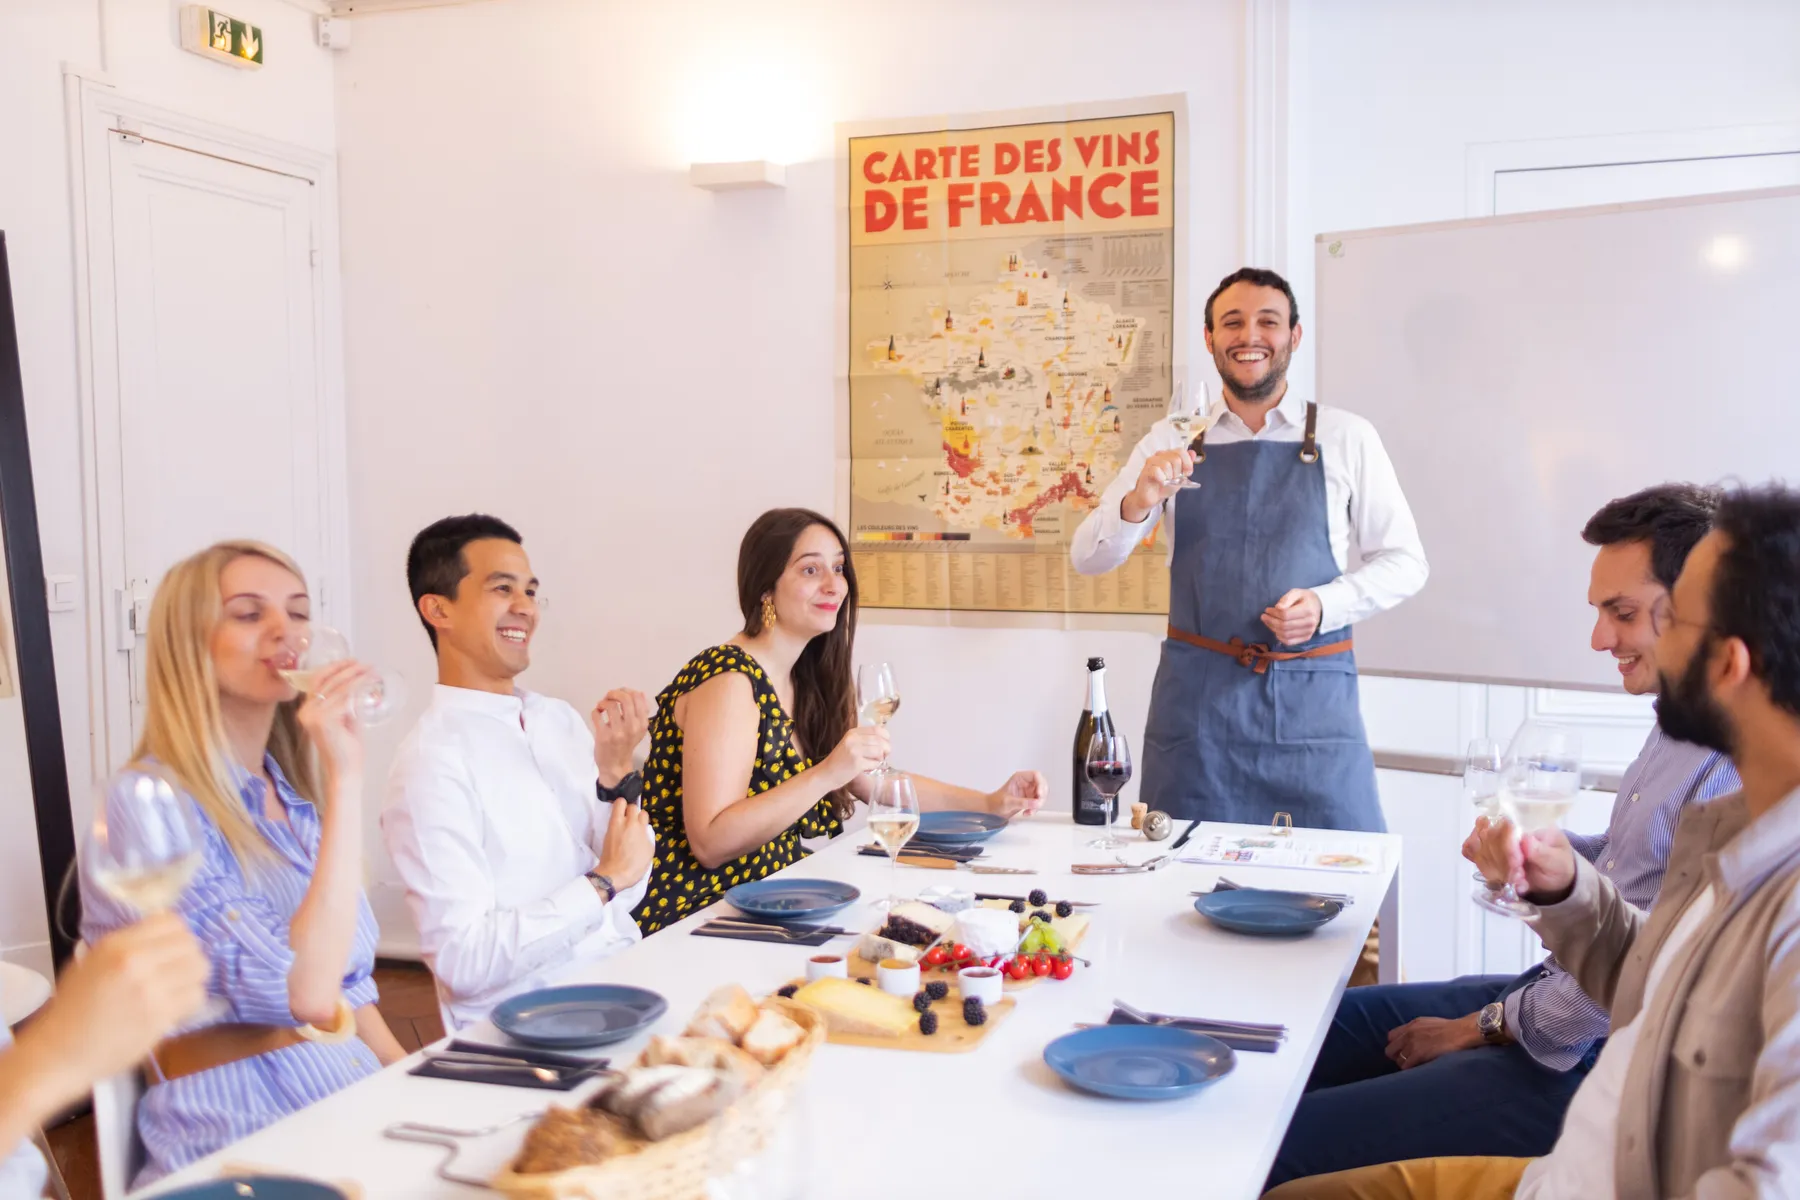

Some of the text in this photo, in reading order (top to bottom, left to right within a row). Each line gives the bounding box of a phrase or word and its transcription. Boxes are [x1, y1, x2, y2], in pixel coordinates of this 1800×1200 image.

[863, 129, 1160, 184] CARTE DES VINS
[864, 169, 1160, 233] DE FRANCE
